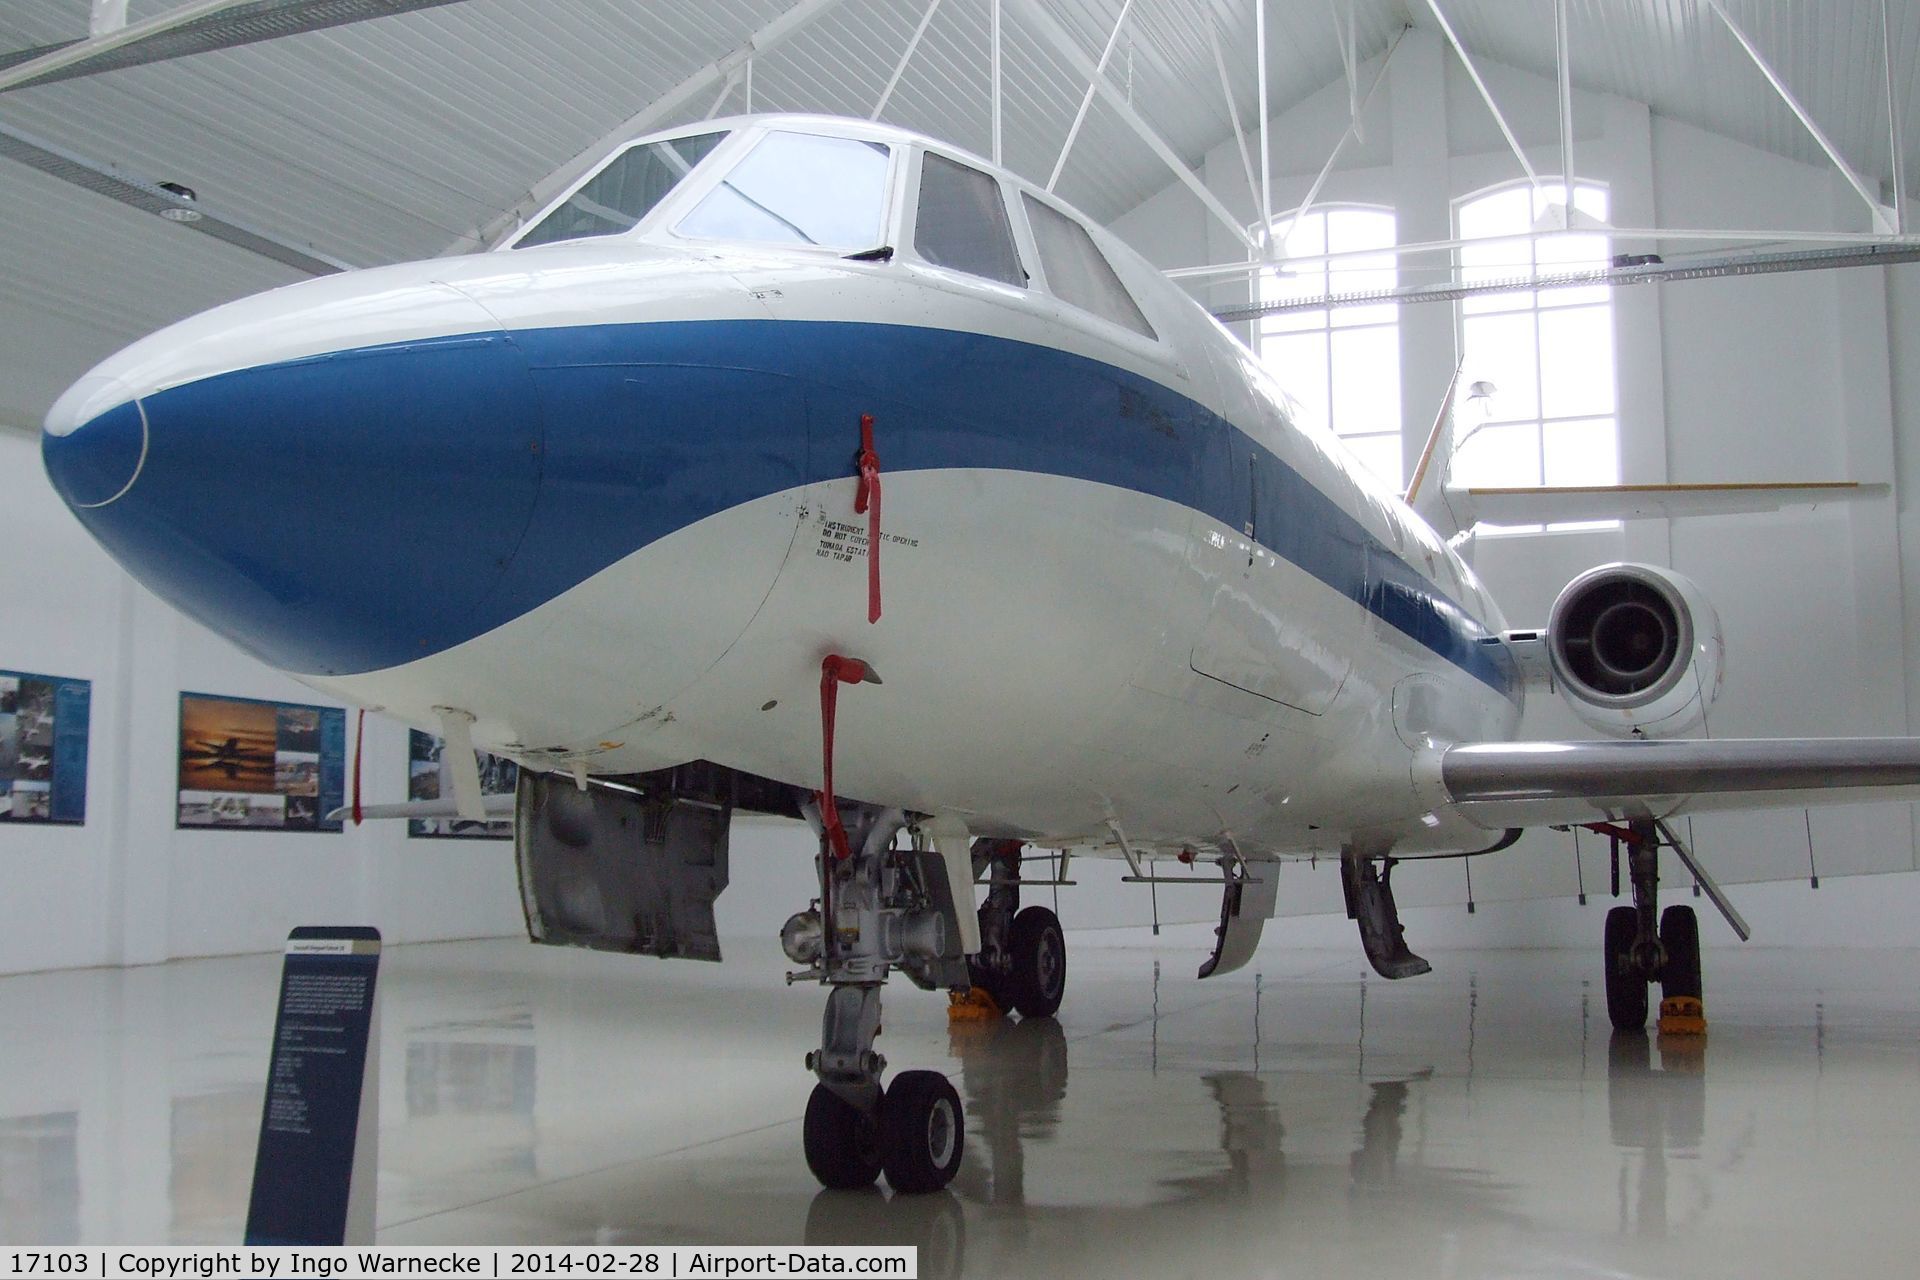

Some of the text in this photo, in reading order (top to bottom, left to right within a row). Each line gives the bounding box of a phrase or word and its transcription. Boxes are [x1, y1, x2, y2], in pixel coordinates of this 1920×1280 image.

[824, 521, 864, 535] INSTRUMENT
[822, 528, 832, 538] DO
[834, 532, 847, 541] NOT
[820, 540, 843, 551] TOMADA
[833, 552, 853, 562] TAPAR
